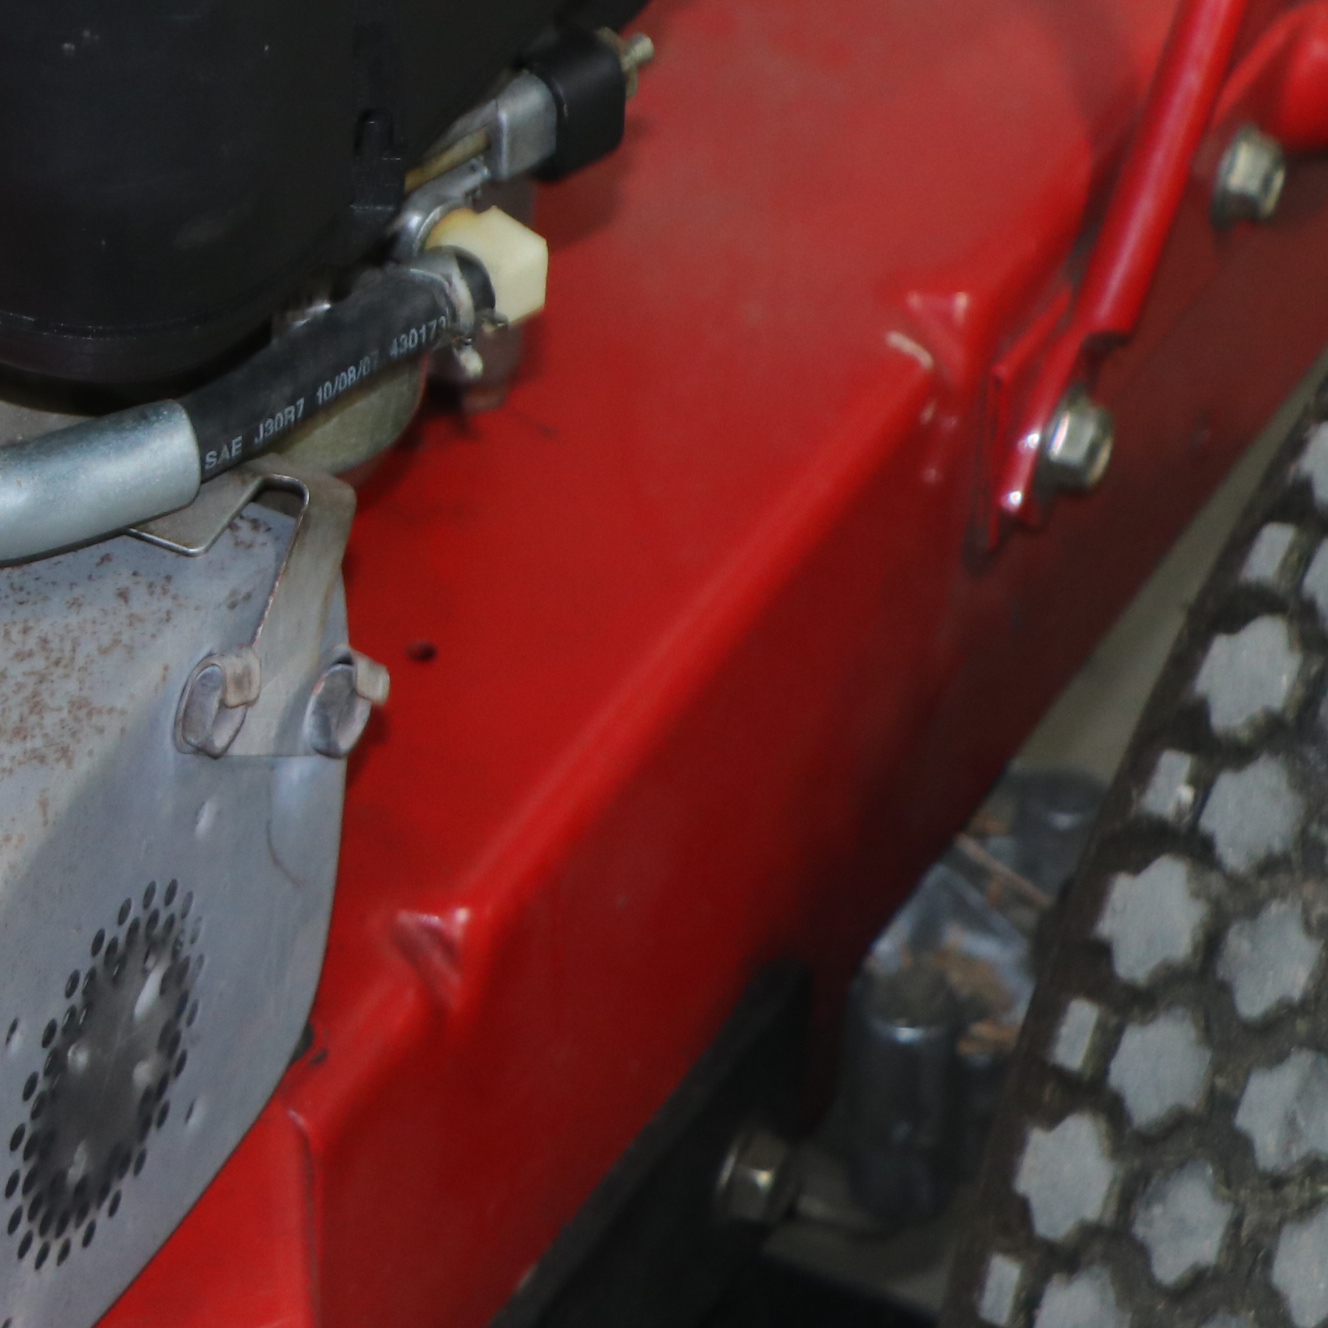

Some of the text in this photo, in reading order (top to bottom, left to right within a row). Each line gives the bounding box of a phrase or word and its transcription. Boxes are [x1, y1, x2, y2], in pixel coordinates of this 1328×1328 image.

[204, 435, 244, 470] SAE
[254, 396, 305, 446] J30R7
[315, 351, 380, 407] 10/08/07
